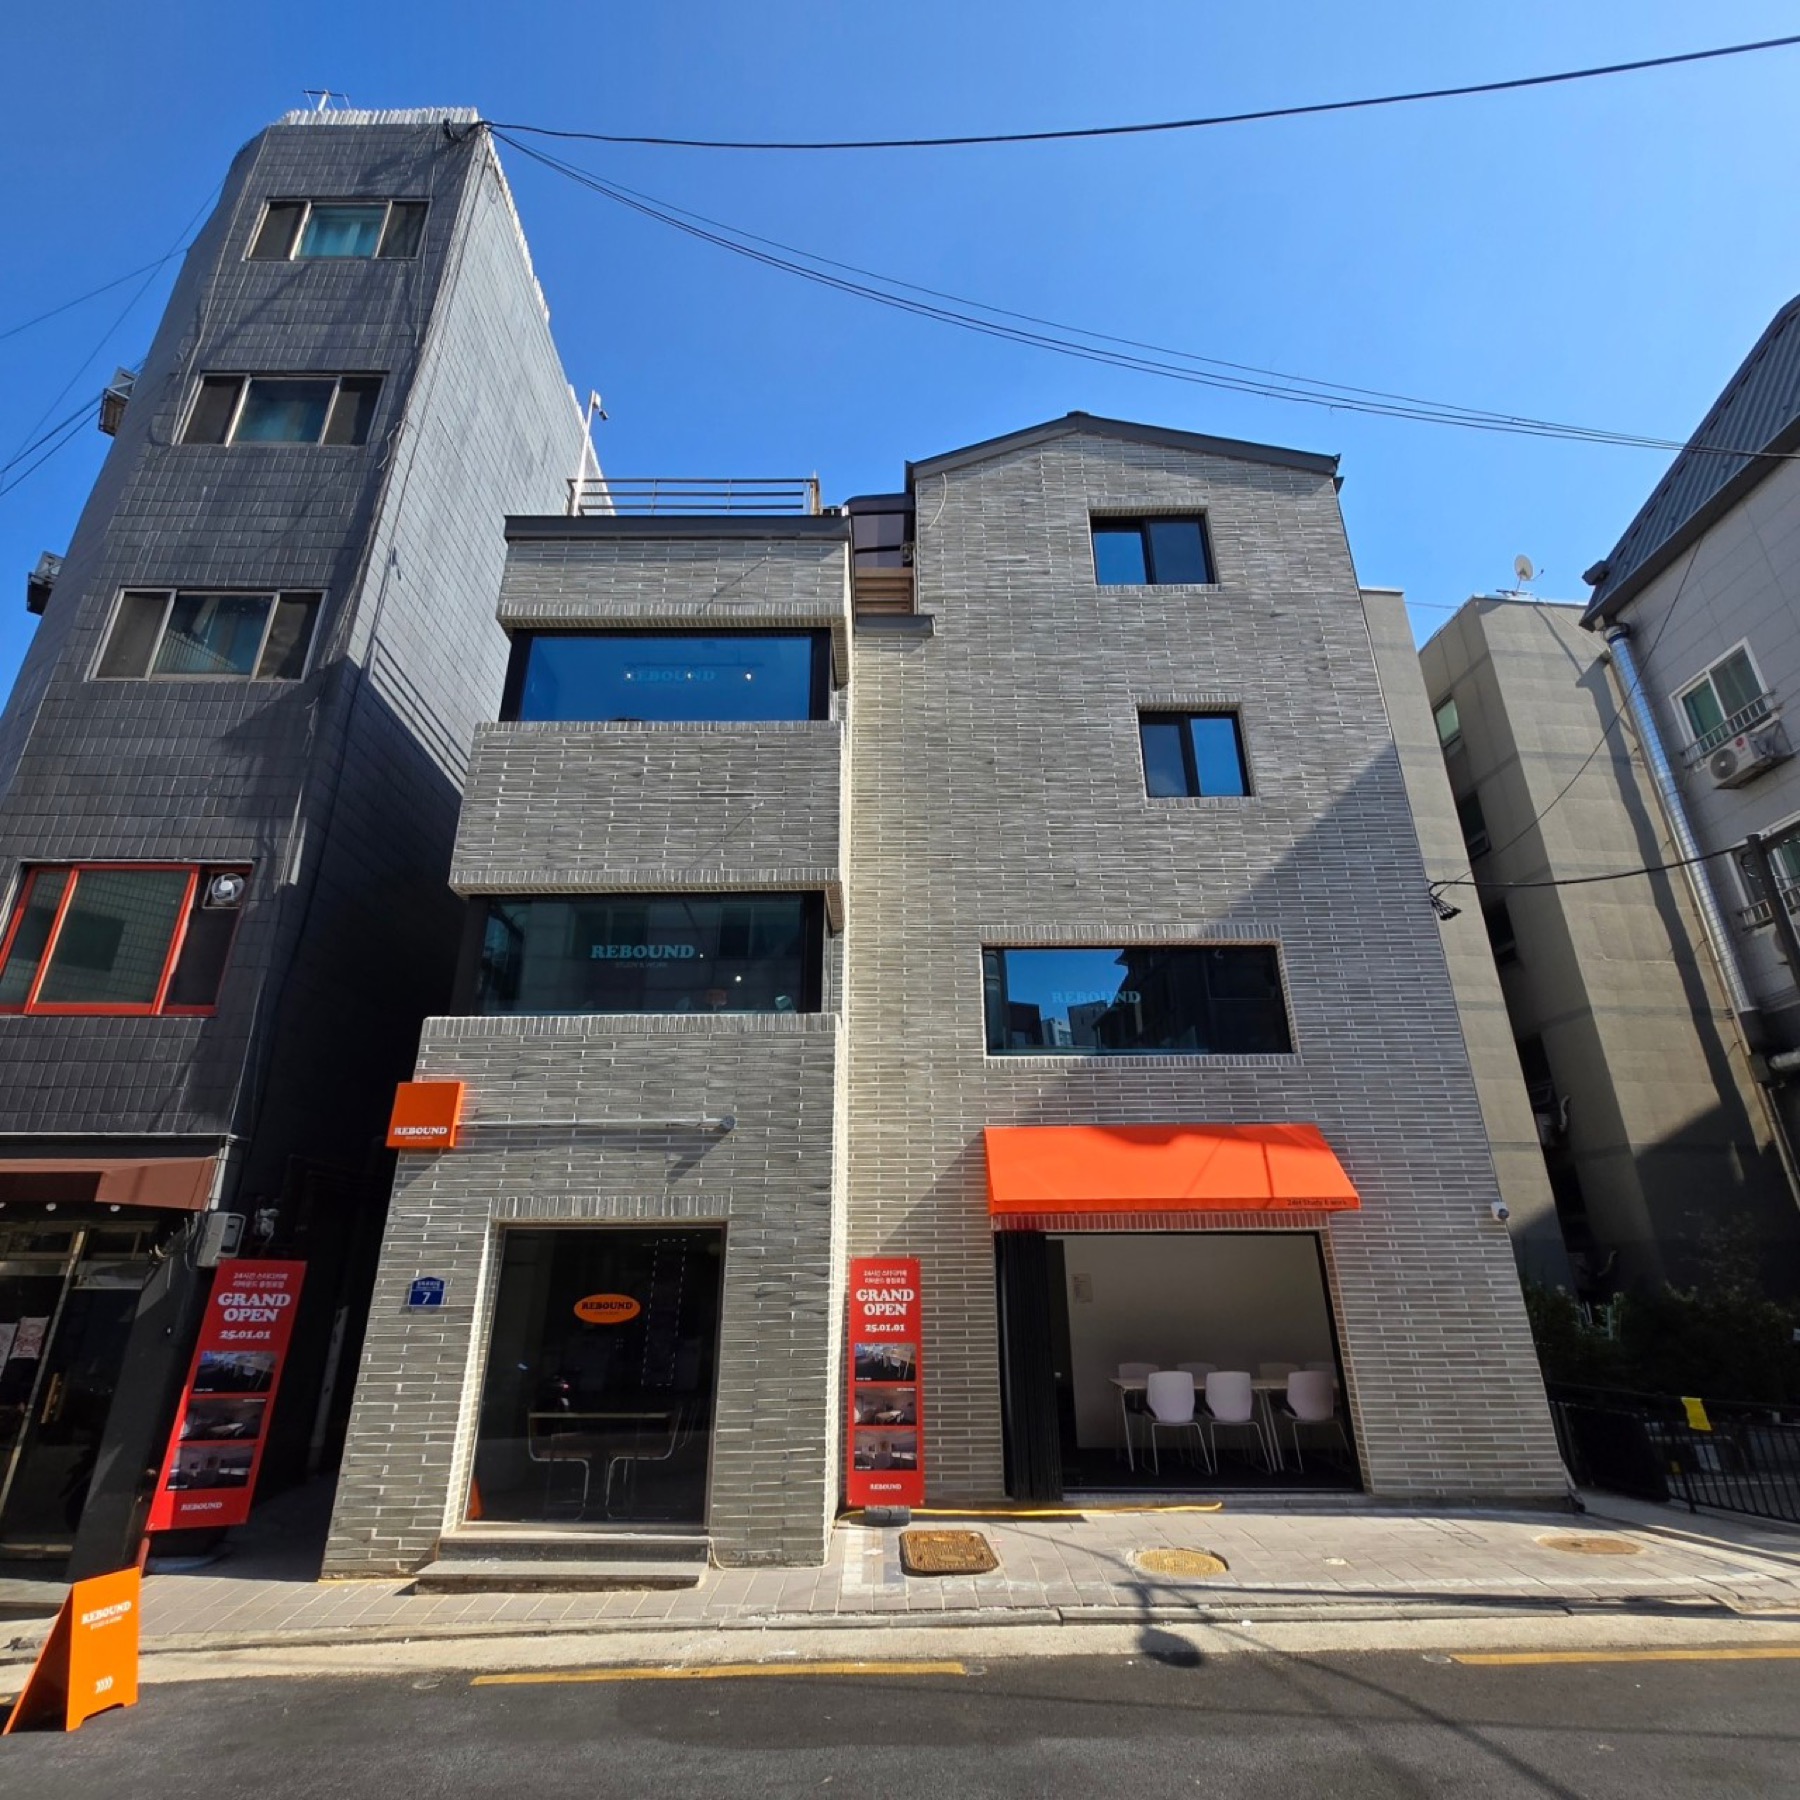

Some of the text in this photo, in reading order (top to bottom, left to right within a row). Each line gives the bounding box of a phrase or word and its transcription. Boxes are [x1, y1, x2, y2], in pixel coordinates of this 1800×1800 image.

[590, 944, 695, 959] REBOUND
[1051, 990, 1141, 1004] REBOUND
[394, 1127, 448, 1136] REBOUND
[217, 1292, 291, 1307] GRAND
[422, 1291, 431, 1305] 7
[855, 1288, 915, 1302] GRAND
[582, 1301, 634, 1310] REBOUND
[863, 1303, 908, 1316] OPEN
[223, 1308, 279, 1322] OPEN
[864, 1323, 905, 1333] 25.01.01
[219, 1330, 271, 1340] 25.01.01
[869, 1483, 902, 1491] REBOUND
[181, 1502, 223, 1511] REBOUND
[81, 1600, 132, 1625] REBOUND
